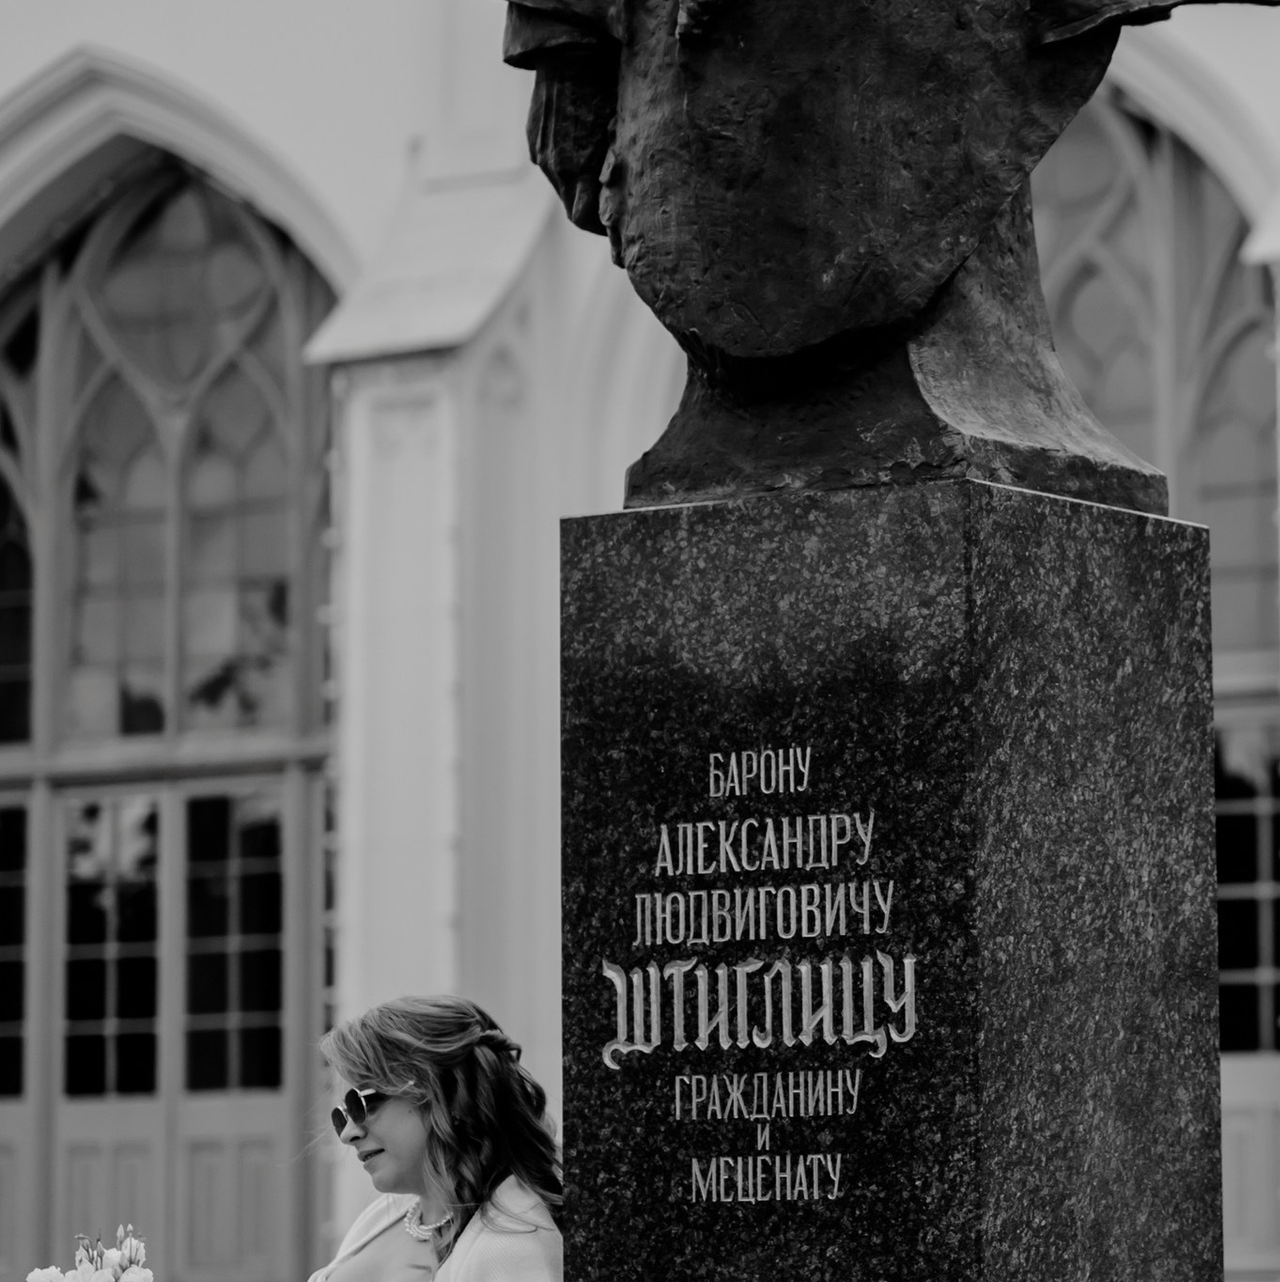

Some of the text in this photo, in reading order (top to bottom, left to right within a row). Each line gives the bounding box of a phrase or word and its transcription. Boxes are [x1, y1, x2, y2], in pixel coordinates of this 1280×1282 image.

[709, 747, 811, 797] БАРОНУ
[655, 810, 874, 876] АЛЕКСАНДРУ
[632, 880, 894, 946] ЛЮДВИГОВИЧУ
[602, 949, 917, 1070] ШТИГЛИЦУ
[675, 1069, 861, 1121] ГРАЖДАНИНУ
[757, 1124, 770, 1151] И
[691, 1153, 842, 1203] МЕЦЕНАТУ
